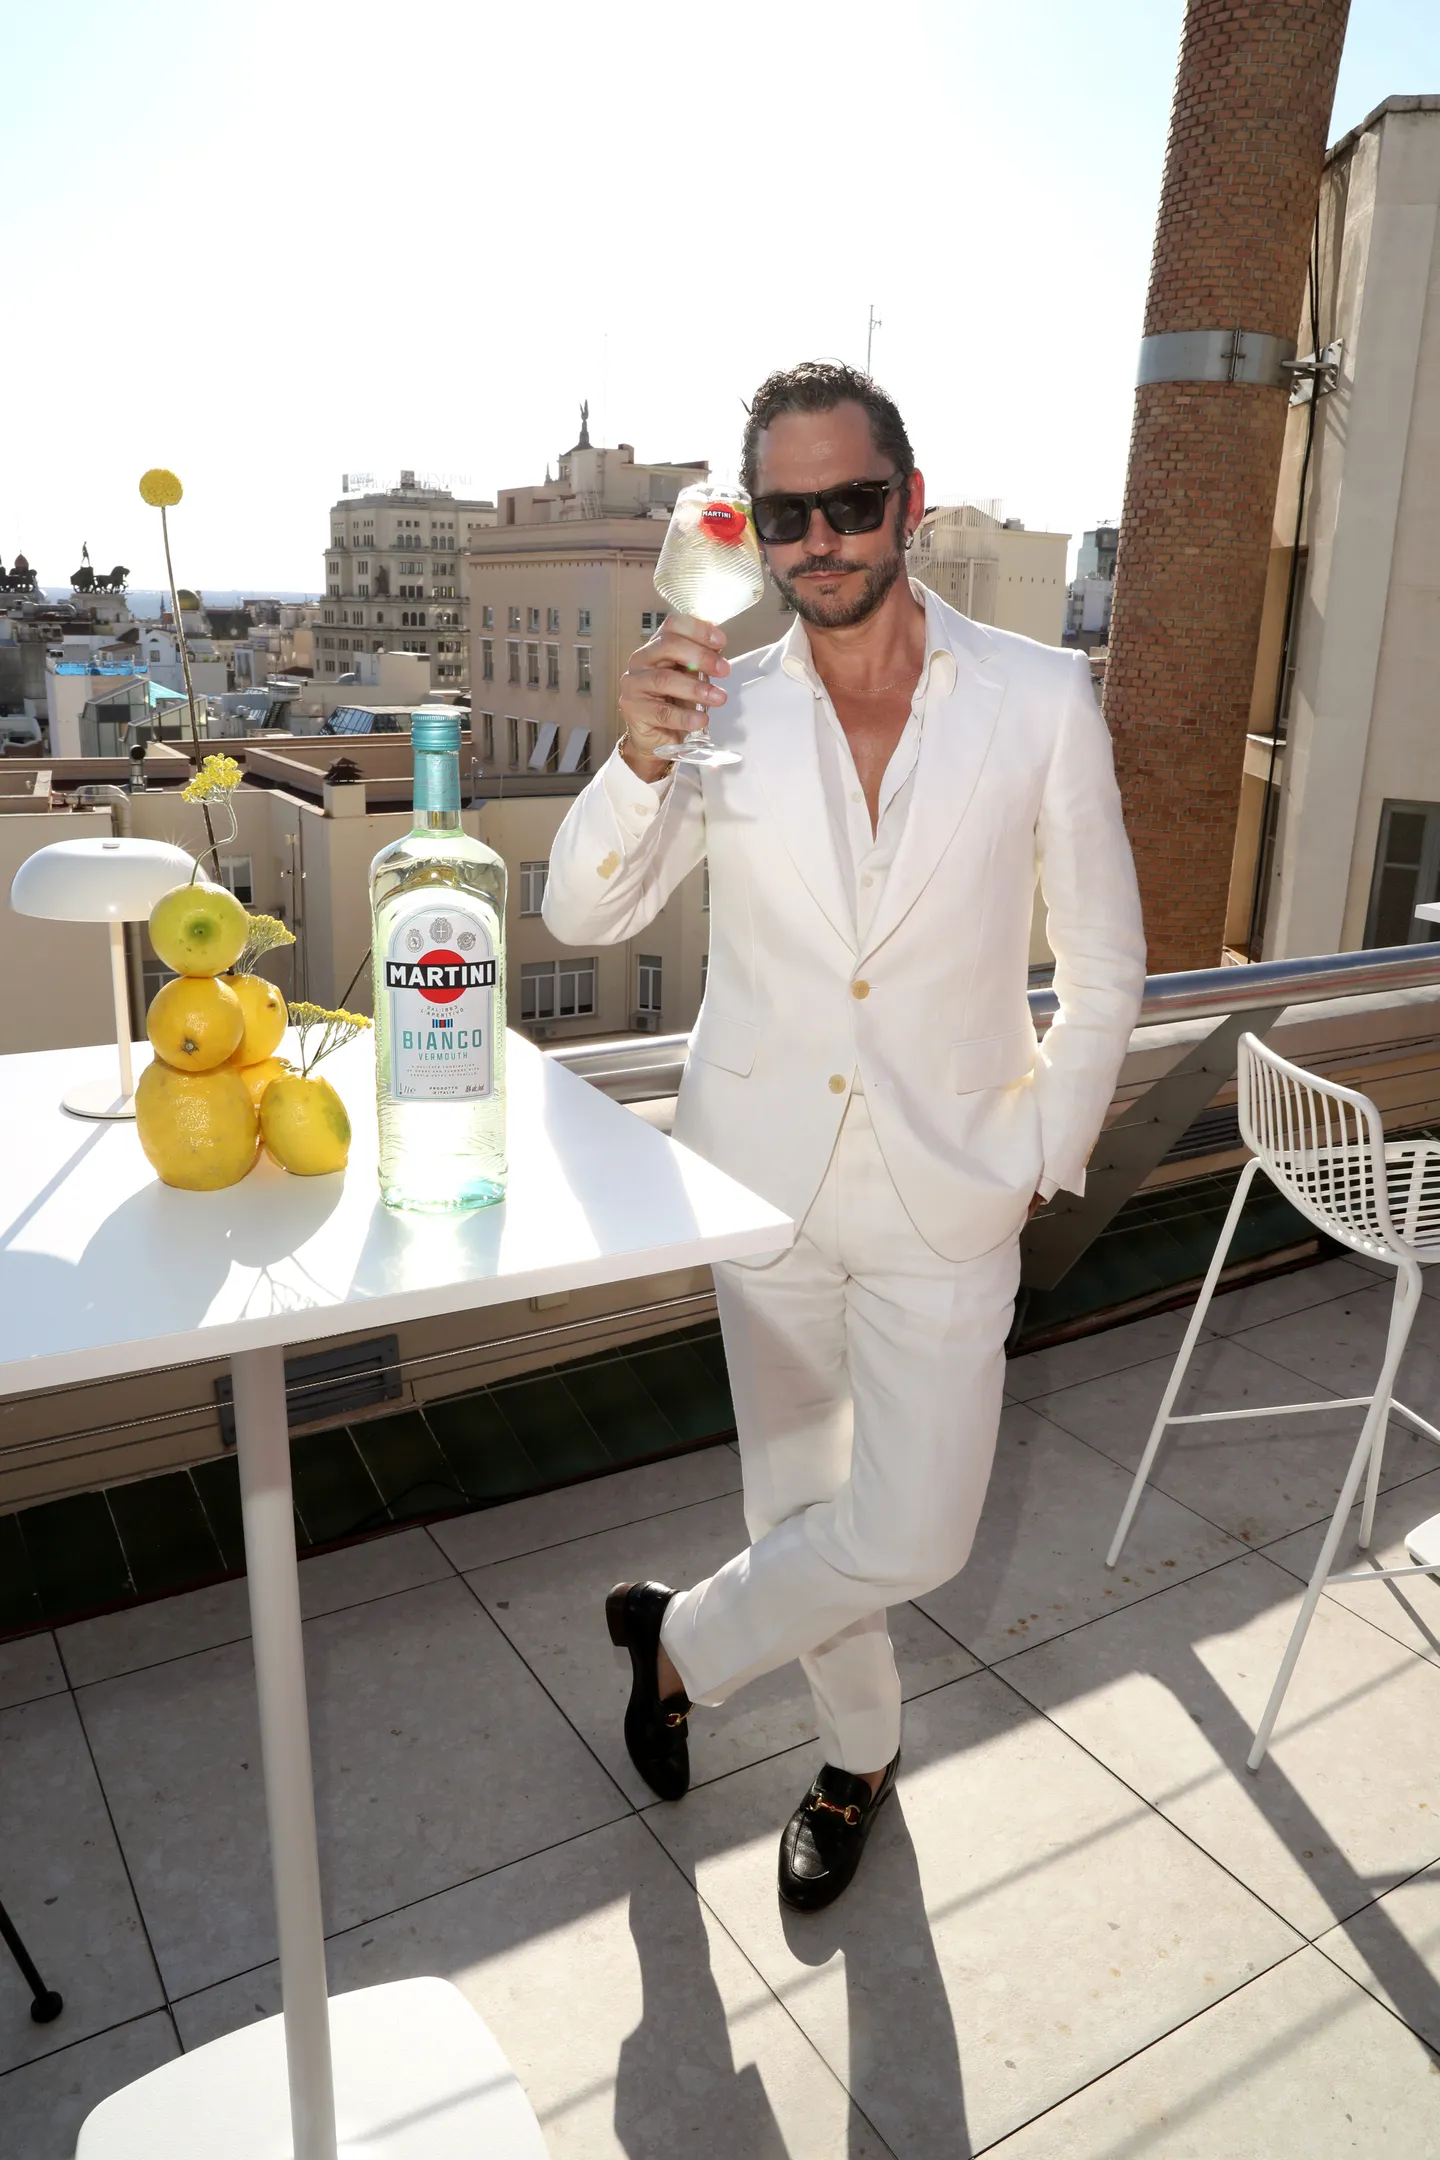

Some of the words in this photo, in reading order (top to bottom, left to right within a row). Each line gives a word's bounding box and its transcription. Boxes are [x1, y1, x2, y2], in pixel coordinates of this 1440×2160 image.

[702, 510, 731, 518] MARTINI
[390, 963, 492, 987] MARTINI
[420, 1007, 464, 1018] L'APERITIVO
[403, 1029, 482, 1050] BIANCO
[418, 1052, 468, 1060] VERMOUTH
